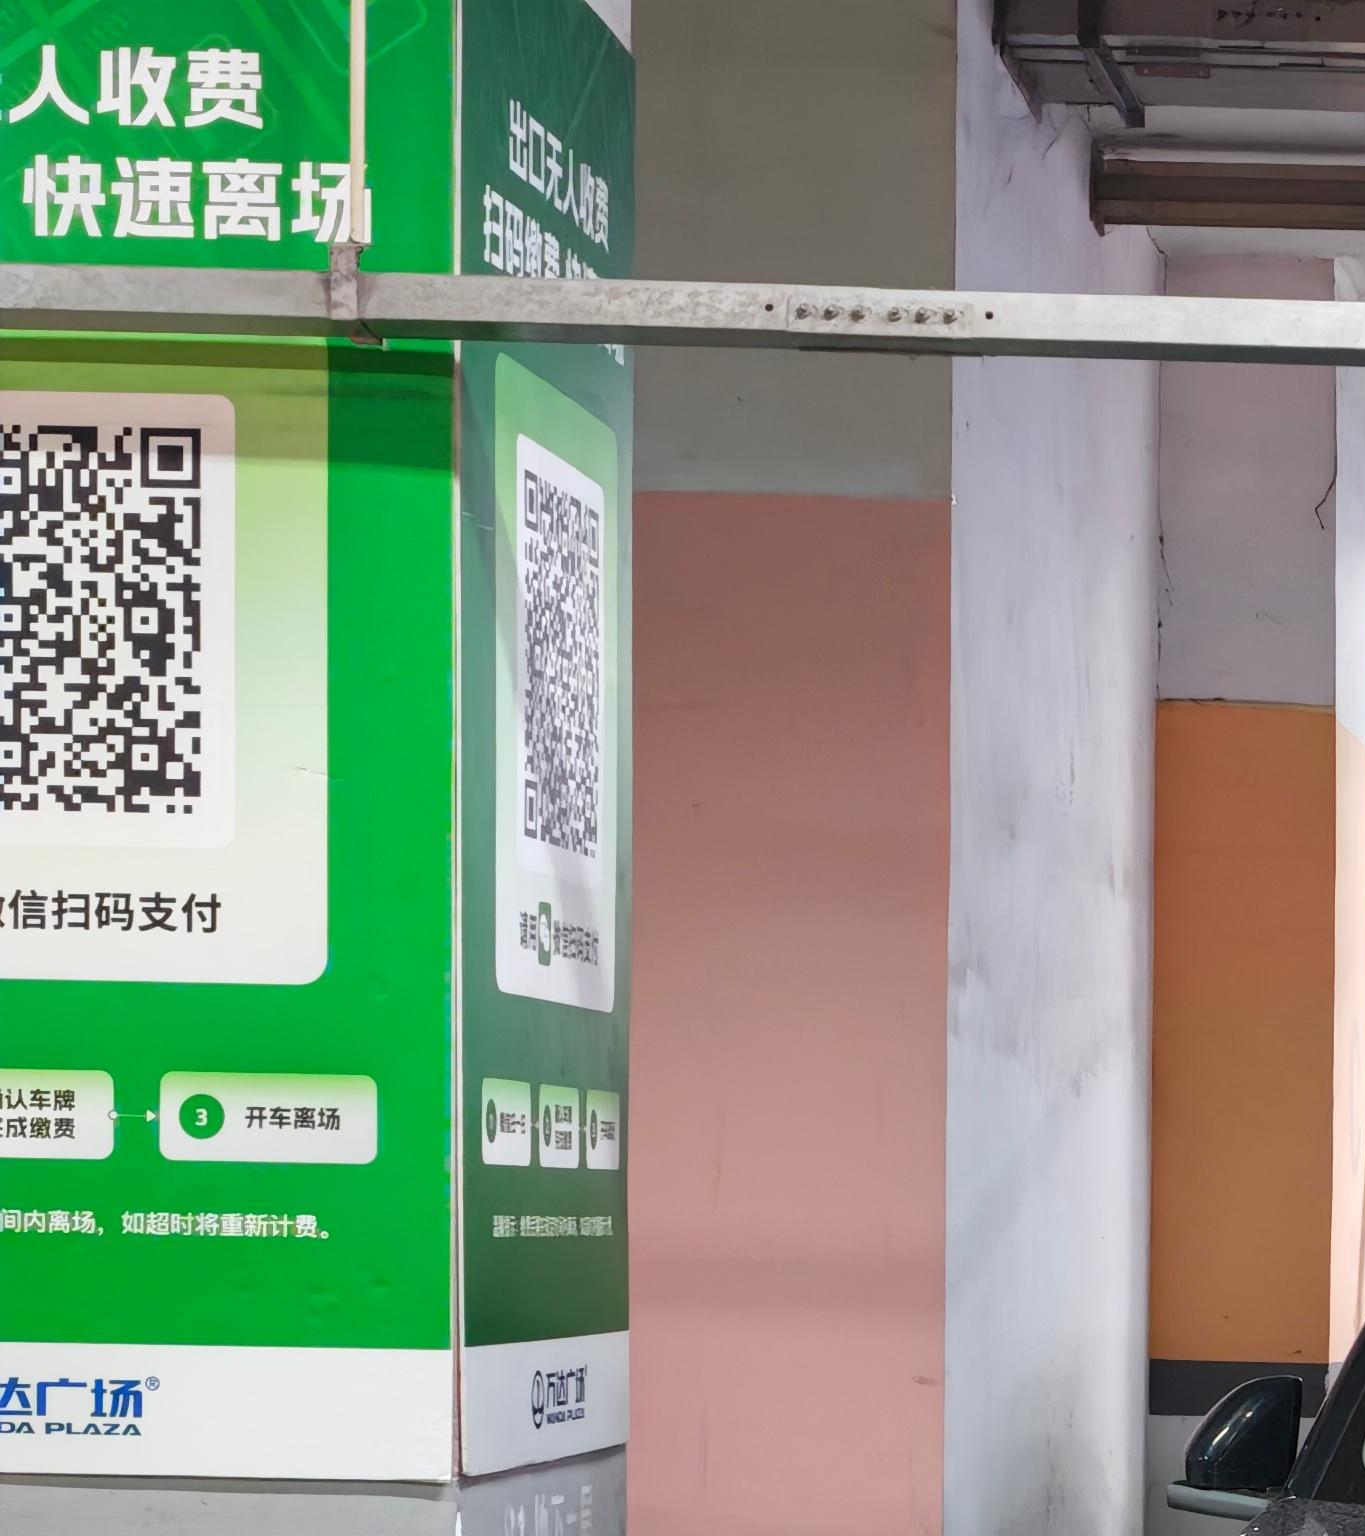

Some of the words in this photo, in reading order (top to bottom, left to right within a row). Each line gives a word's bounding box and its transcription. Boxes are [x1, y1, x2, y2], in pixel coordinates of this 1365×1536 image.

[0, 44, 264, 129] 人收费
[23, 154, 372, 243] 快速离场
[508, 99, 609, 254] 出口无人收费
[483, 184, 560, 279] 扫码缴费
[194, 1107, 209, 1127] 3
[244, 1106, 341, 1132] 开车离场
[44, 1422, 142, 1436] PLAZA
[546, 1367, 587, 1408] 万达广场
